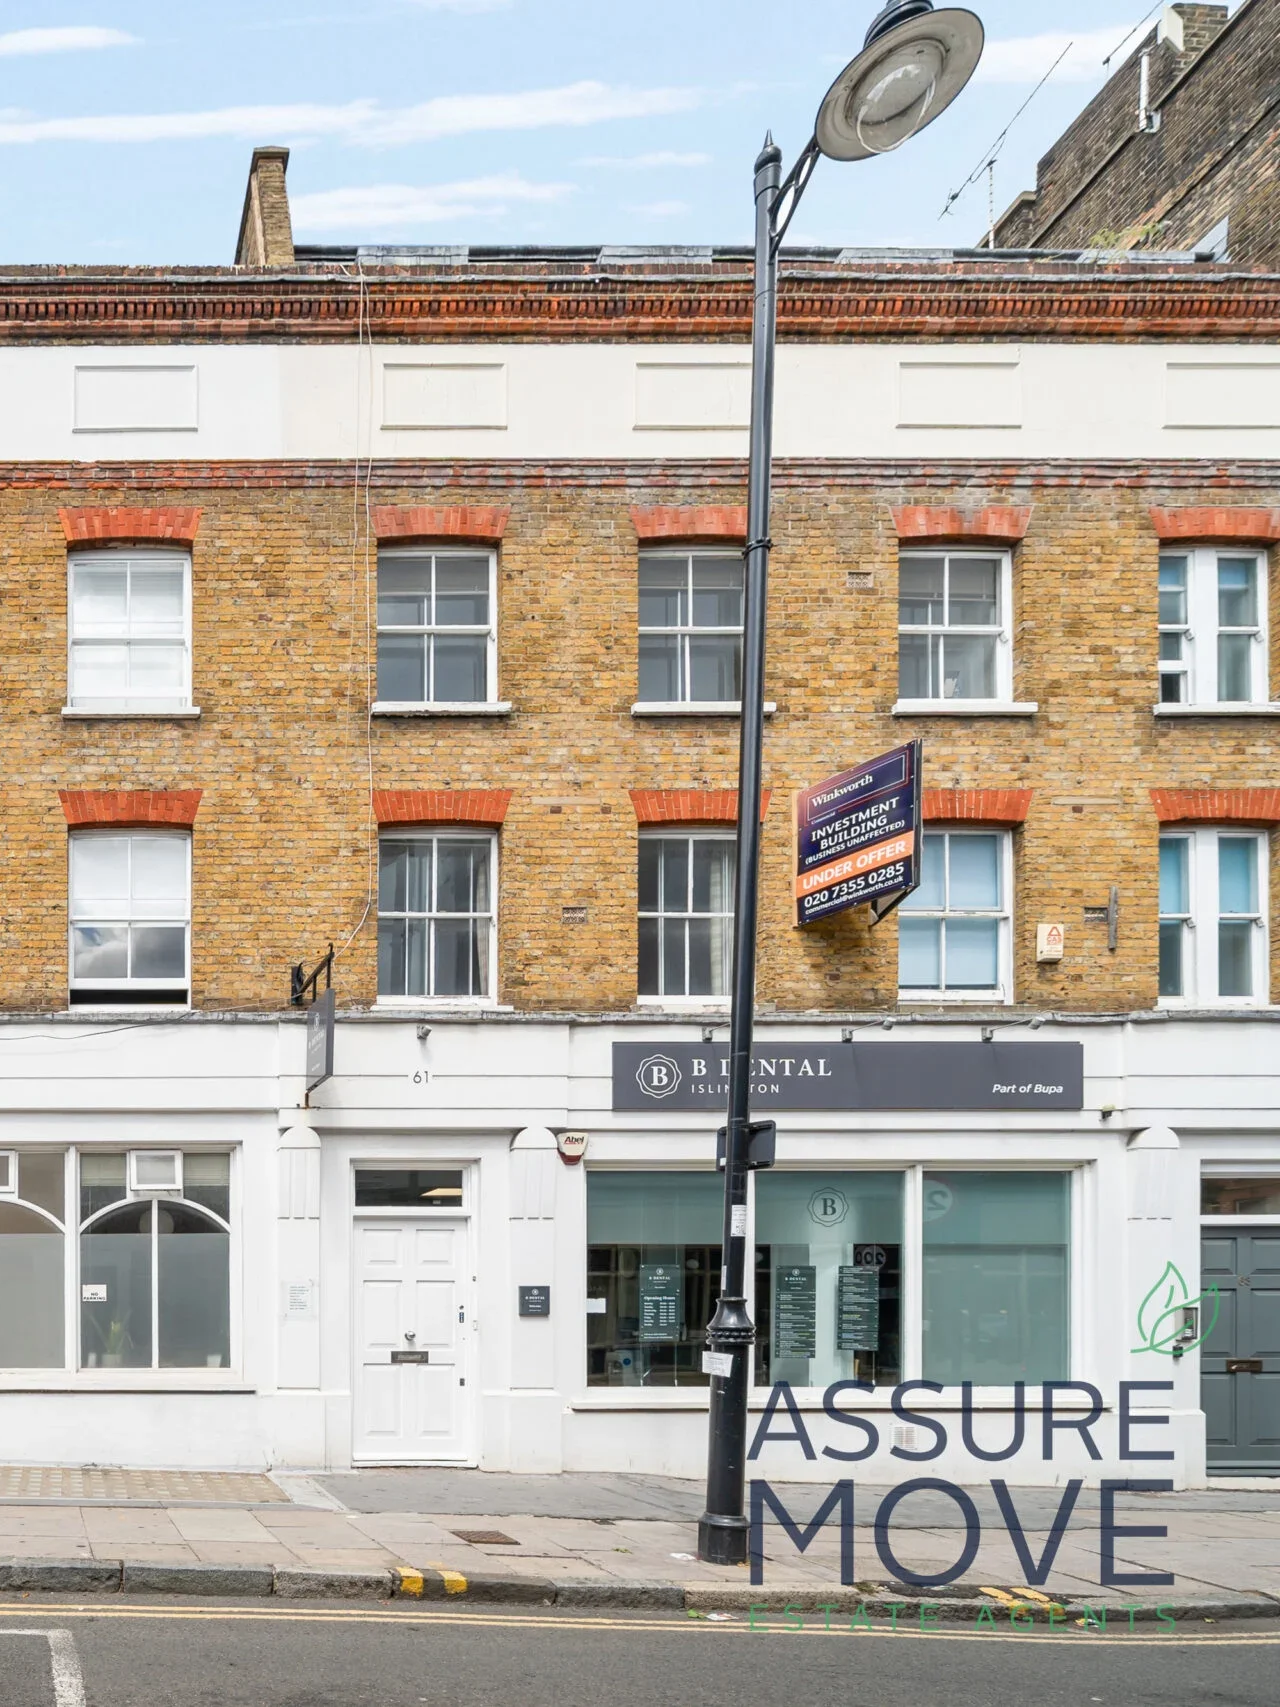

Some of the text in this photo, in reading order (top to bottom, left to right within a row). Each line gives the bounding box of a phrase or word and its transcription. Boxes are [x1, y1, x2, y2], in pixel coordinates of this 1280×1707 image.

[811, 774, 873, 807] Winkworth
[811, 796, 900, 842] INVESTMENT
[820, 814, 888, 850] BUILDING
[805, 819, 906, 865] (BUSINESS UNAFFECTED)
[802, 840, 907, 890] UNDER OFFER
[804, 862, 905, 908] 020 7355 0285
[805, 875, 904, 915] commercial@winkworth.co.uk
[412, 1070, 429, 1084] 61
[650, 1065, 669, 1086] B
[691, 1058, 707, 1076] B
[691, 1084, 780, 1094] ISLINTON
[992, 1083, 1063, 1095] Part of Bupa
[820, 1197, 838, 1217] B
